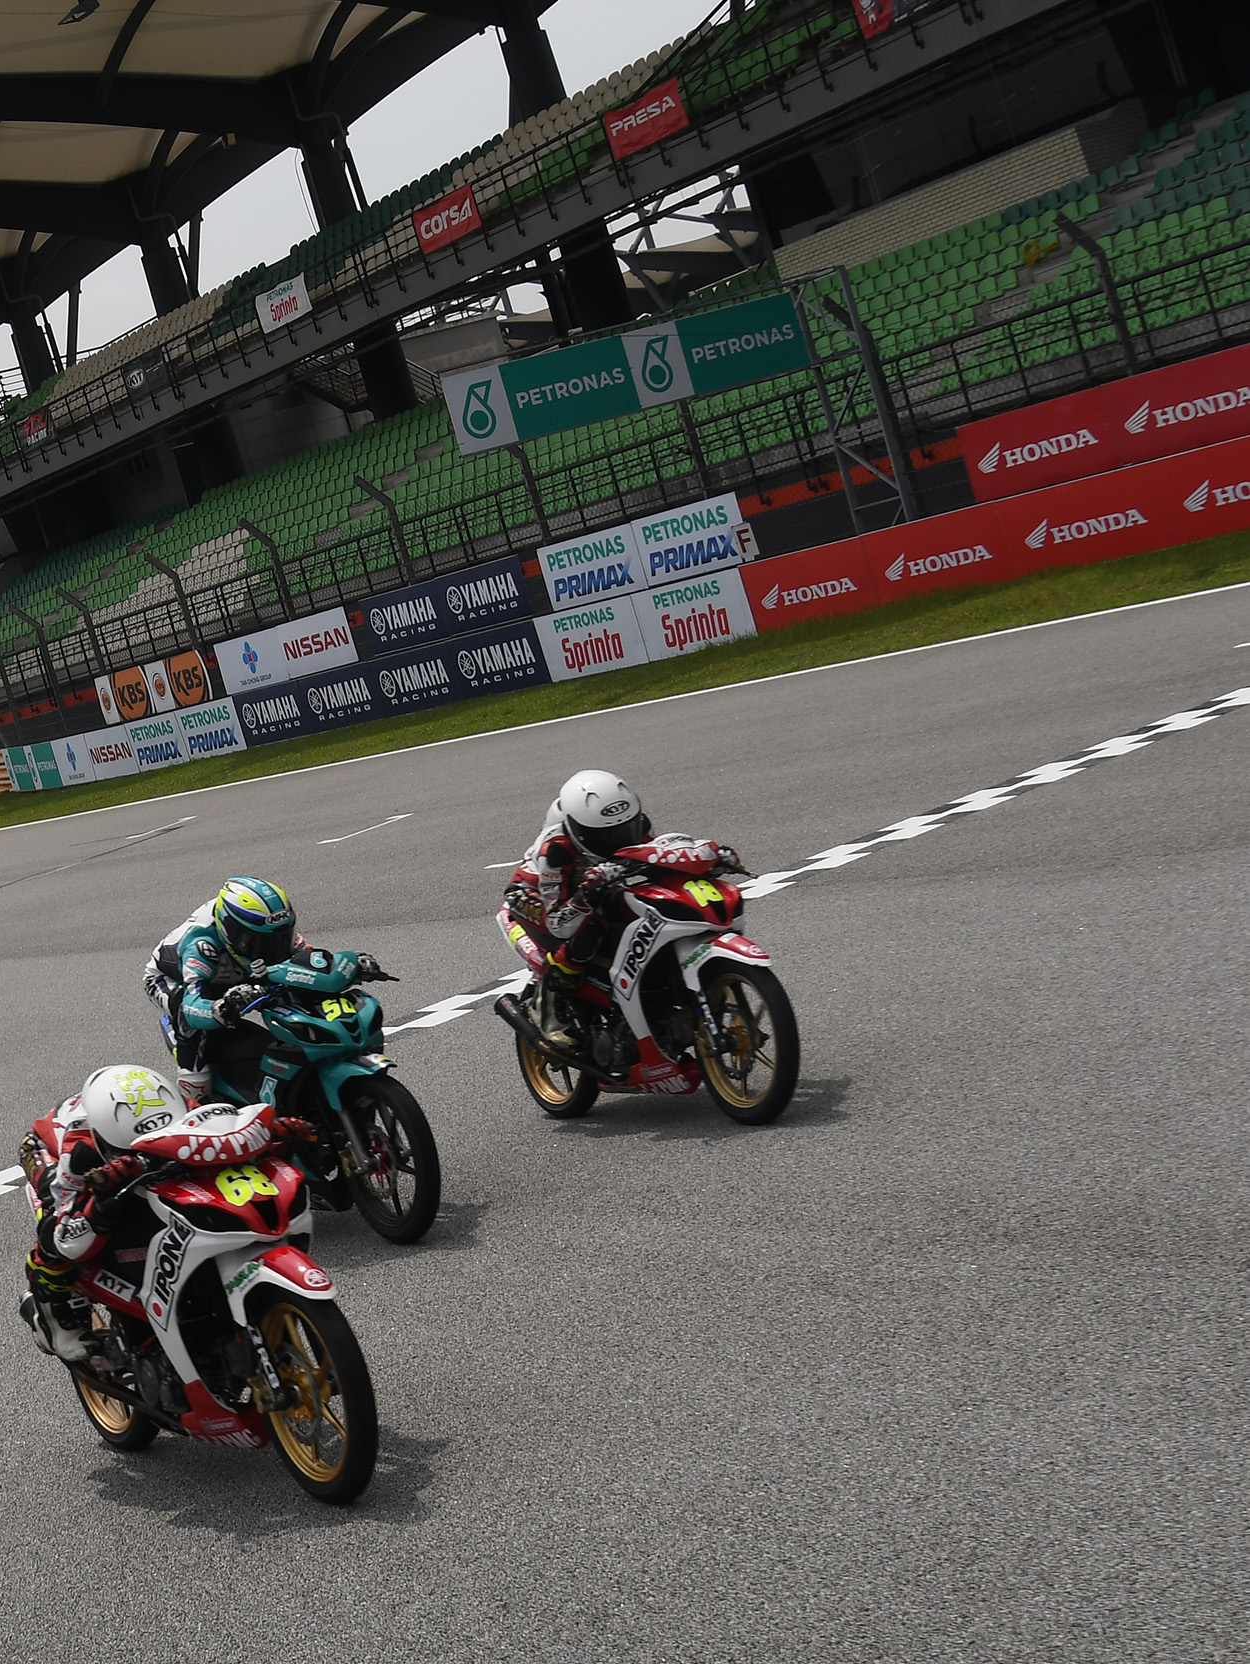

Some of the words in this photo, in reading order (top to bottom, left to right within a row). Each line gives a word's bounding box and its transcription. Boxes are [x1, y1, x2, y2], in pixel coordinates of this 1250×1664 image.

[610, 96, 676, 137] PRESA
[269, 295, 298, 322] Sprinta
[692, 324, 795, 363] PETRONAS
[515, 367, 626, 409] PETRONAS
[1002, 428, 1099, 468] HONDA
[642, 505, 728, 544] PETRONAS
[1051, 508, 1148, 545] HONDA
[546, 535, 625, 572] PETRONAS
[649, 530, 739, 577] PRIMAX
[736, 528, 751, 553] F
[907, 544, 993, 577] HONDA
[459, 572, 519, 609] YAMAHA
[554, 556, 635, 602] PRIMAX
[781, 576, 858, 606] HONDA
[652, 580, 721, 610] PETRONAS
[382, 595, 437, 630] YAMAHA
[457, 601, 518, 622] RACING
[553, 606, 615, 633] PETRONAS
[380, 624, 436, 642] RACING
[661, 603, 730, 651] Sprinta
[283, 626, 350, 661] NISSAN
[471, 637, 537, 675] YAMAHA
[561, 629, 625, 673] Sprinta
[173, 666, 203, 696] KBS
[392, 658, 450, 693] YAMAHA
[470, 667, 536, 688] RACING
[118, 681, 146, 710] KBS
[319, 677, 372, 711] YAMAHA
[391, 687, 450, 706] RACING
[180, 705, 231, 730] PETRONAS
[253, 694, 301, 725] YAMAHA
[318, 703, 372, 722] RACING
[130, 720, 174, 743] PETRONAS
[188, 725, 239, 755] PRIMAX
[252, 721, 301, 736] RACING
[90, 741, 132, 765] NISSAN
[137, 739, 182, 766] PRIMAX
[602, 802, 628, 816] KYT
[683, 879, 725, 907] 18
[268, 911, 290, 924] NHK
[624, 913, 663, 979] IPONE
[286, 972, 316, 985] Sprinta
[321, 998, 357, 1022] 50
[136, 1113, 171, 1133] KYT
[215, 1165, 280, 1207] 68
[154, 1220, 192, 1305] IPONE
[97, 1268, 132, 1295] KYT
